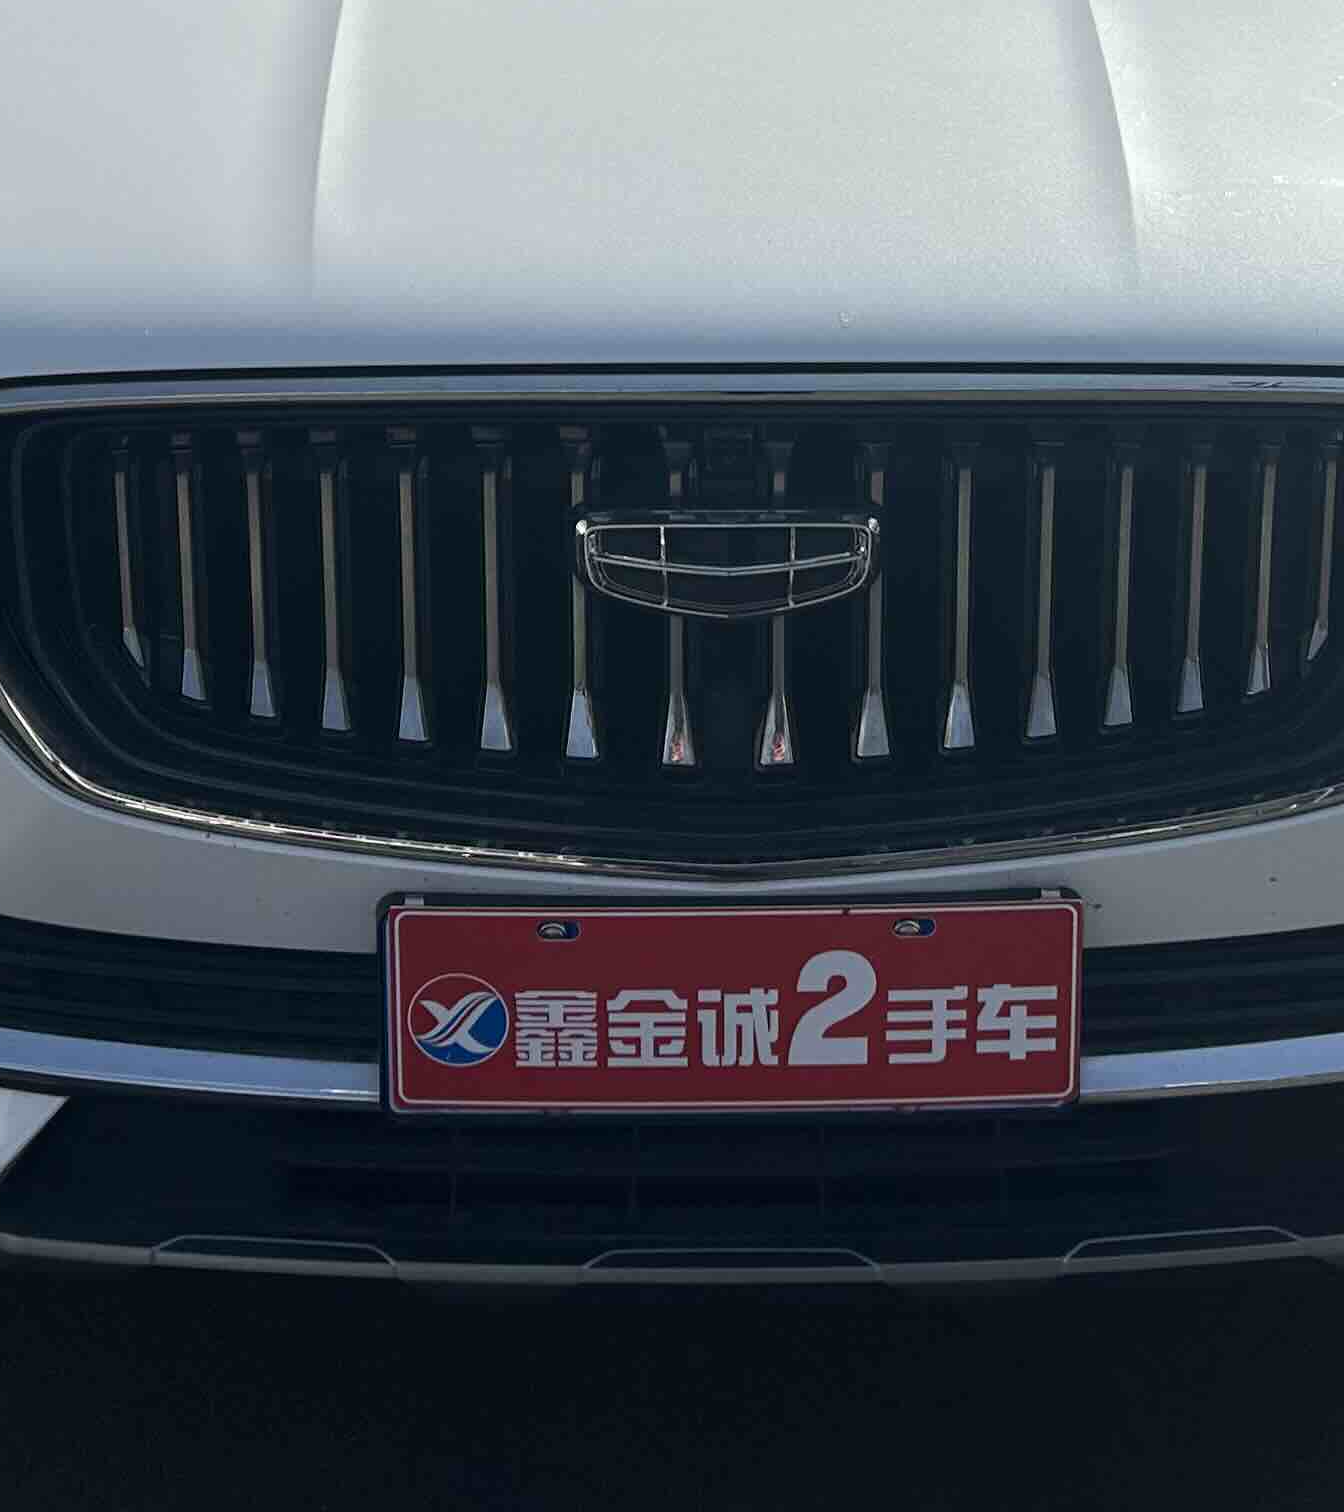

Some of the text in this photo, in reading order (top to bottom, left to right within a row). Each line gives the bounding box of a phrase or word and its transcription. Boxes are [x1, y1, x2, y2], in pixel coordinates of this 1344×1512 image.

[513, 948, 1059, 1068] 鑫金诚2手车
